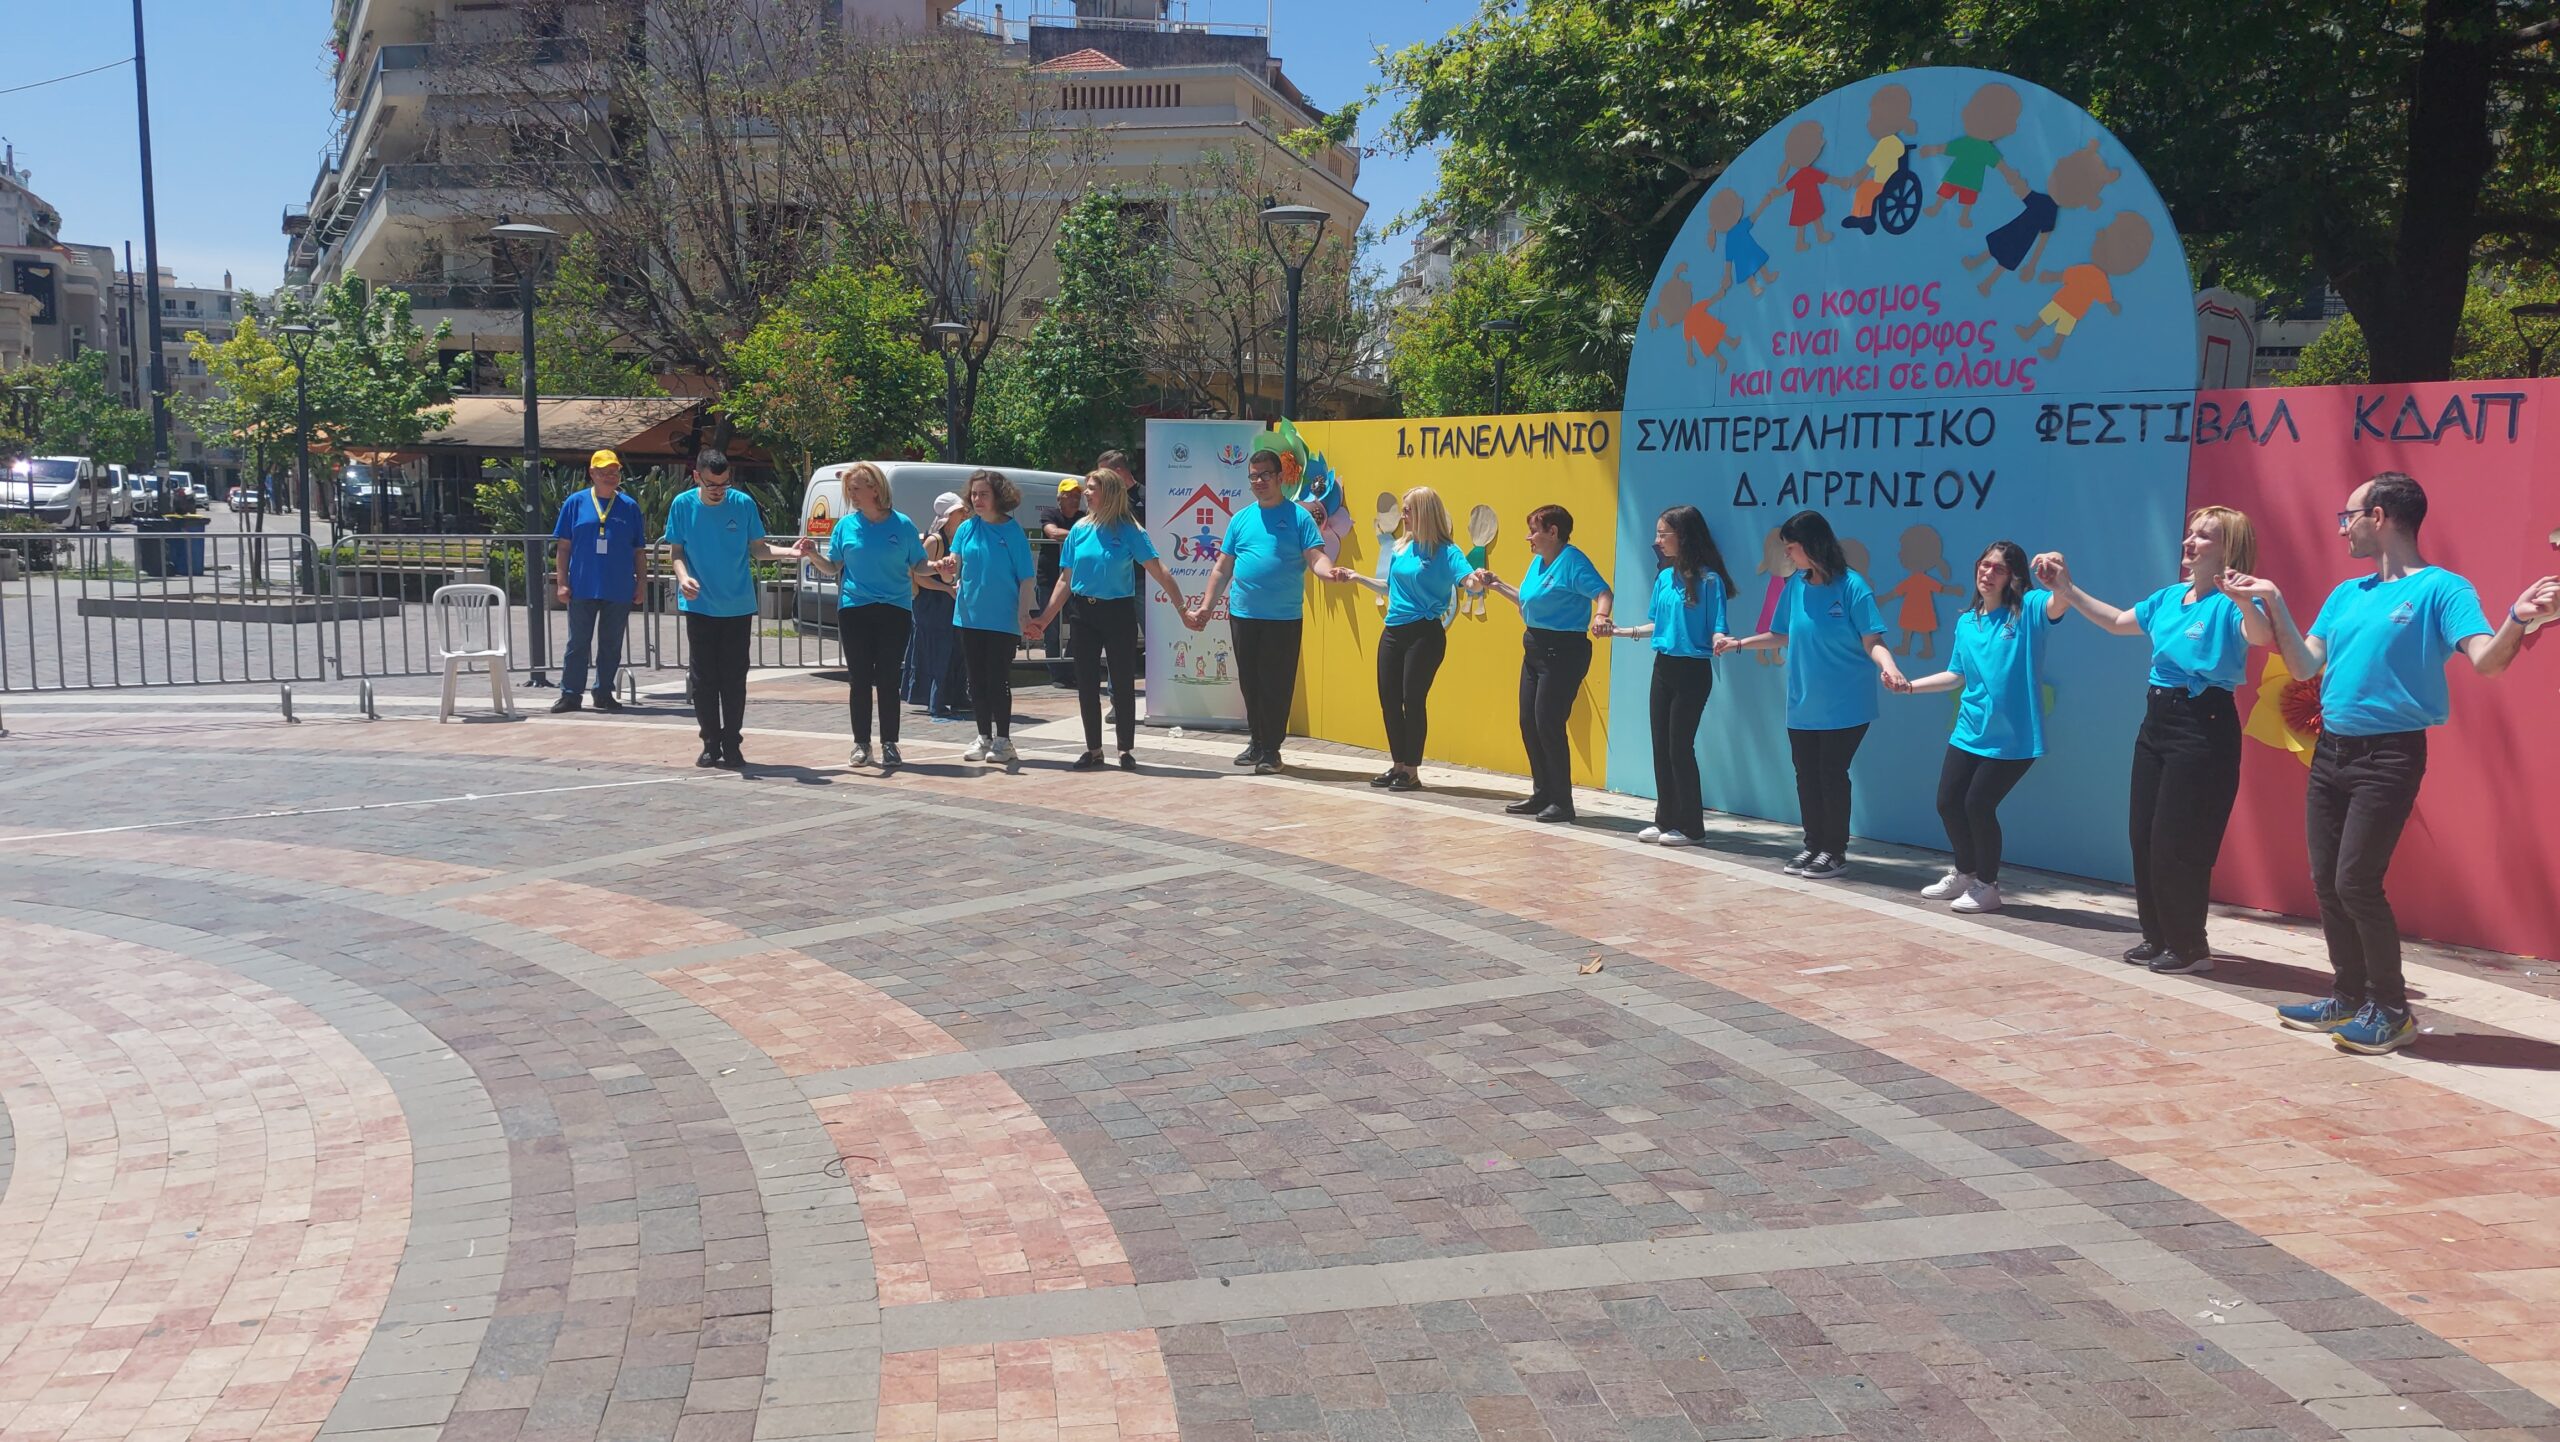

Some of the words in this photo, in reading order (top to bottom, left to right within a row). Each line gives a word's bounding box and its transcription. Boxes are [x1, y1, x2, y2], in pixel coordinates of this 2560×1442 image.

[1792, 293, 1811, 319] ο
[1820, 281, 1941, 320] κοσμος
[1772, 328, 1840, 356] ειναι
[1855, 320, 1998, 358] ομορφος
[1730, 369, 1772, 398] και
[1780, 364, 1880, 397] ανηκει
[1889, 362, 1928, 390] σε
[1934, 352, 2037, 393] ολους
[1420, 420, 1610, 458] ΠΑΝΕΛΛΗΝΙΟ
[1636, 407, 1996, 452] ΣΥΜΠΕΡΙΛΗΠΤΙΚΟ
[2035, 398, 2300, 445] ΦΕΣΤΙΒΑΛ
[2353, 392, 2527, 443] ΚΔΑΠ
[1168, 487, 1193, 496] ΚΔΑΠ
[1218, 488, 1242, 497] ΑΜΕΑ
[1732, 471, 1767, 507] Δ.
[1776, 469, 1996, 510] ΑΓΡΙΝΙΟΥ
